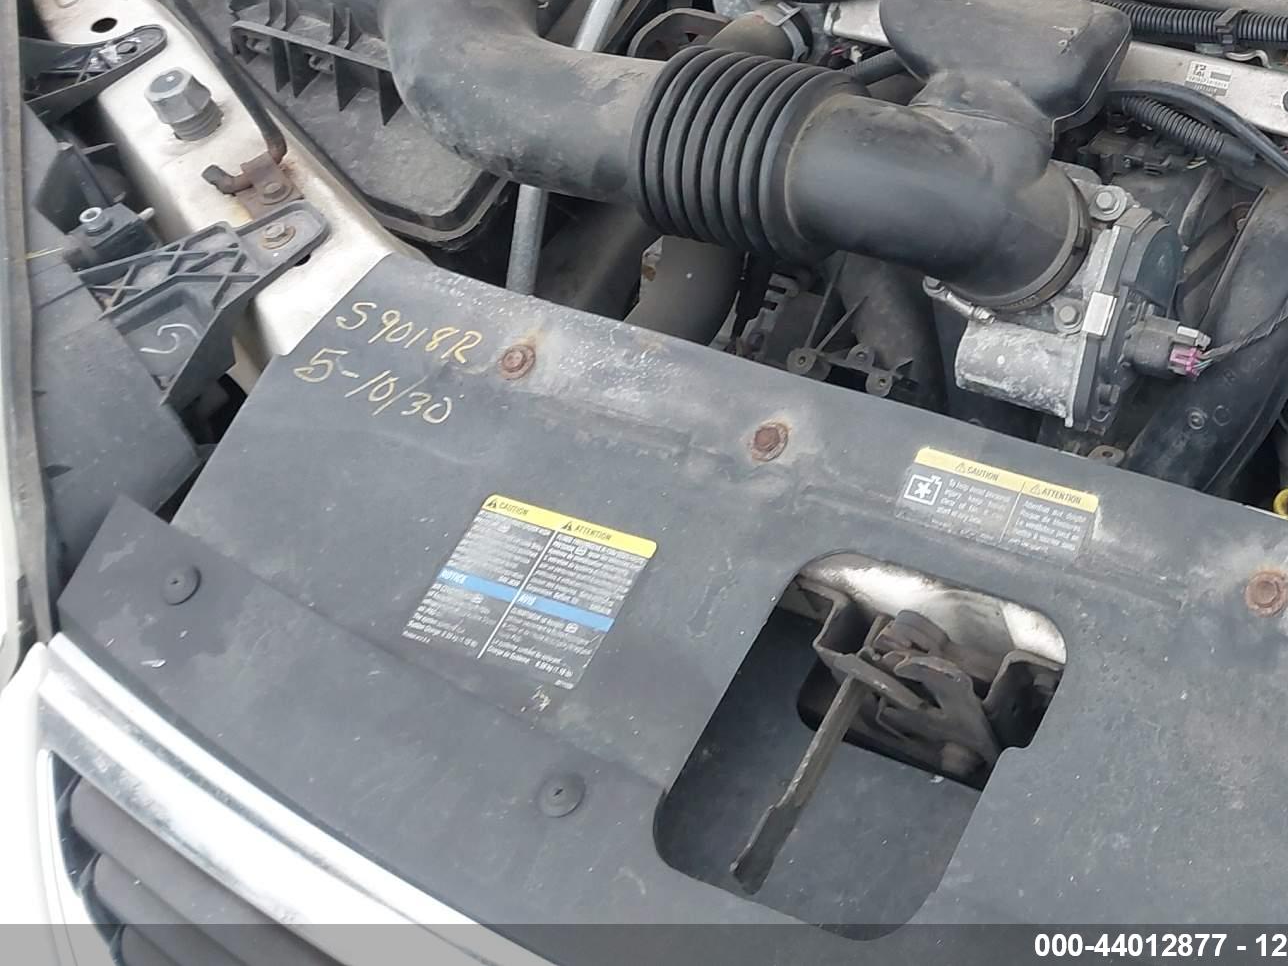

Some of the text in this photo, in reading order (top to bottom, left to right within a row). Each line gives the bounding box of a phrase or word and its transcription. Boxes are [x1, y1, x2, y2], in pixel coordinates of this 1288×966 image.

[967, 466, 999, 482] CAUTION
[1041, 488, 1082, 505] ATTENTION
[499, 501, 529, 517] CAUTION
[574, 524, 612, 541] ATTENTION
